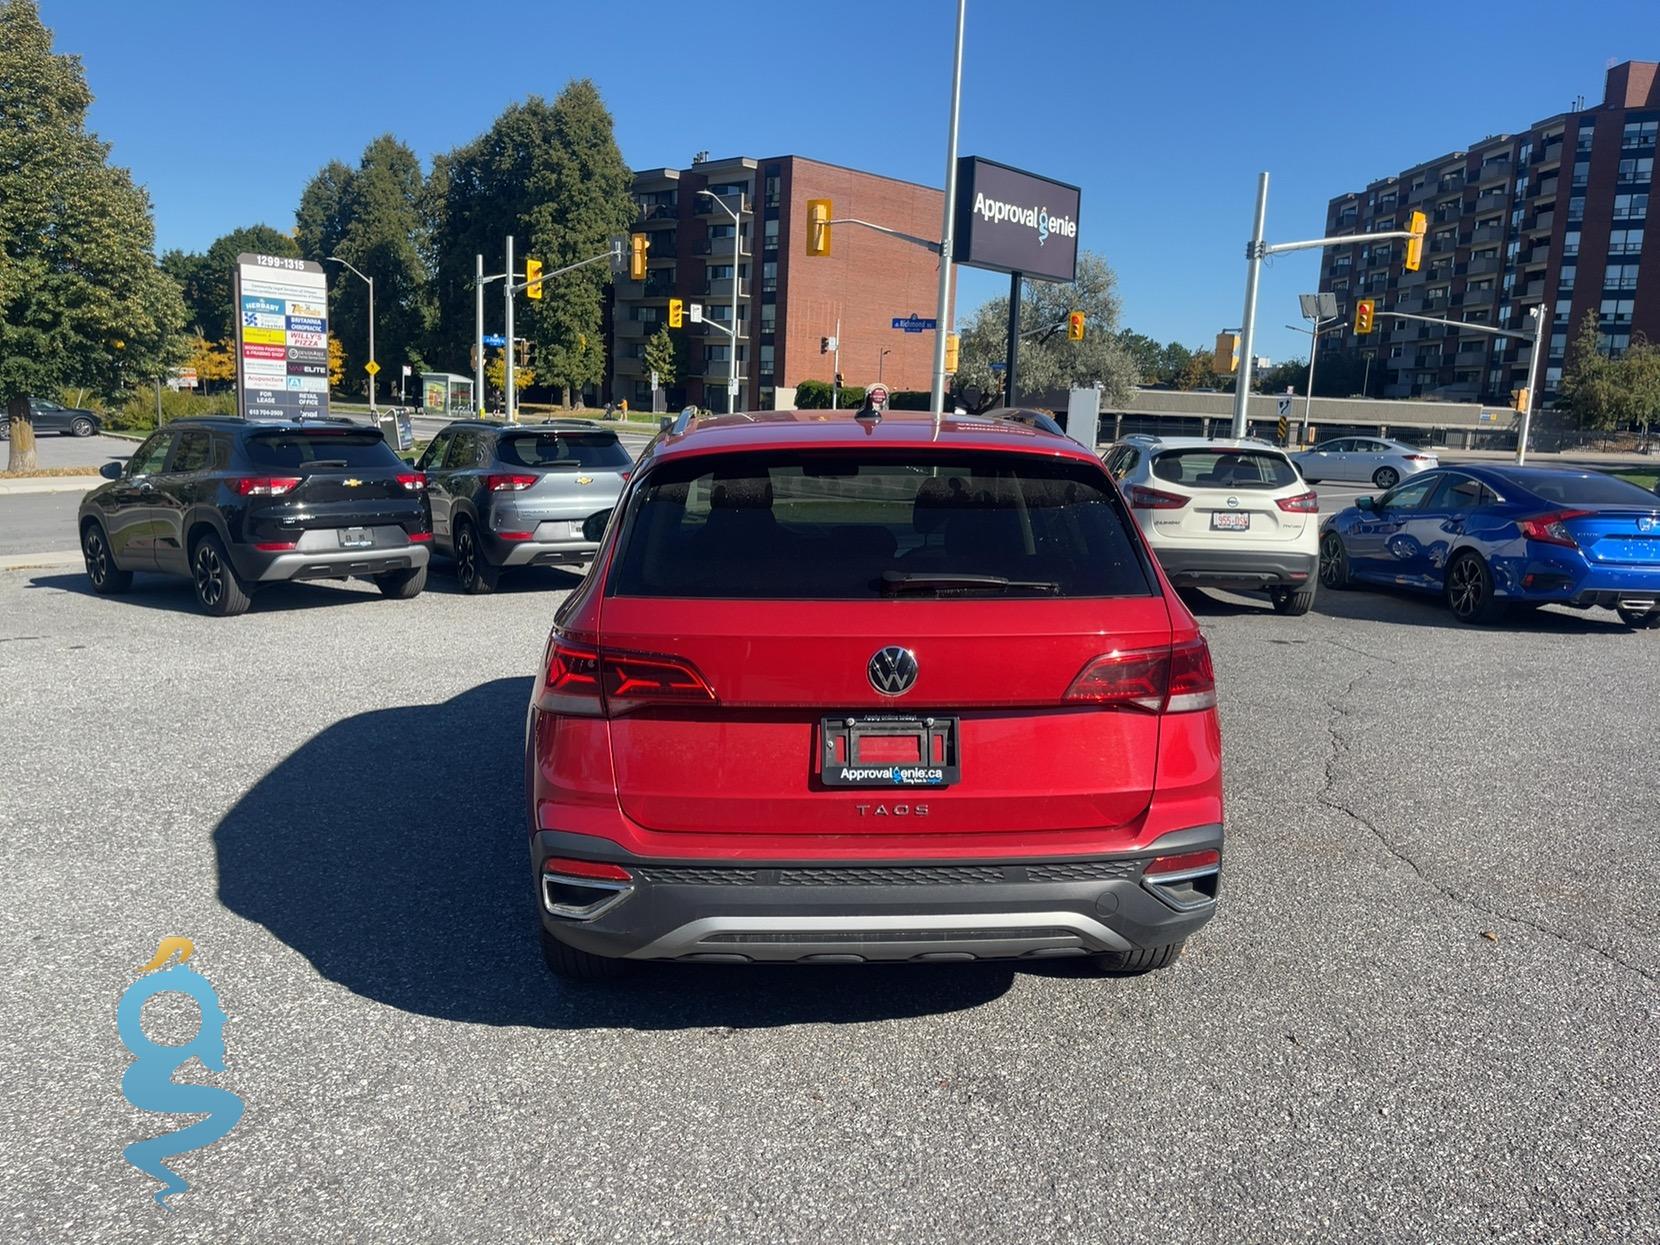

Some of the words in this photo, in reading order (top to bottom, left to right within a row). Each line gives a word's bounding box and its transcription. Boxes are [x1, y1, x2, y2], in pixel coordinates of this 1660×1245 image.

[257, 255, 305, 271] 1299-1315
[291, 317, 322, 325] BRITANNIA
[291, 332, 322, 341] WILLY'S
[295, 339, 319, 347] PIZZA
[856, 804, 929, 816] TAOS
